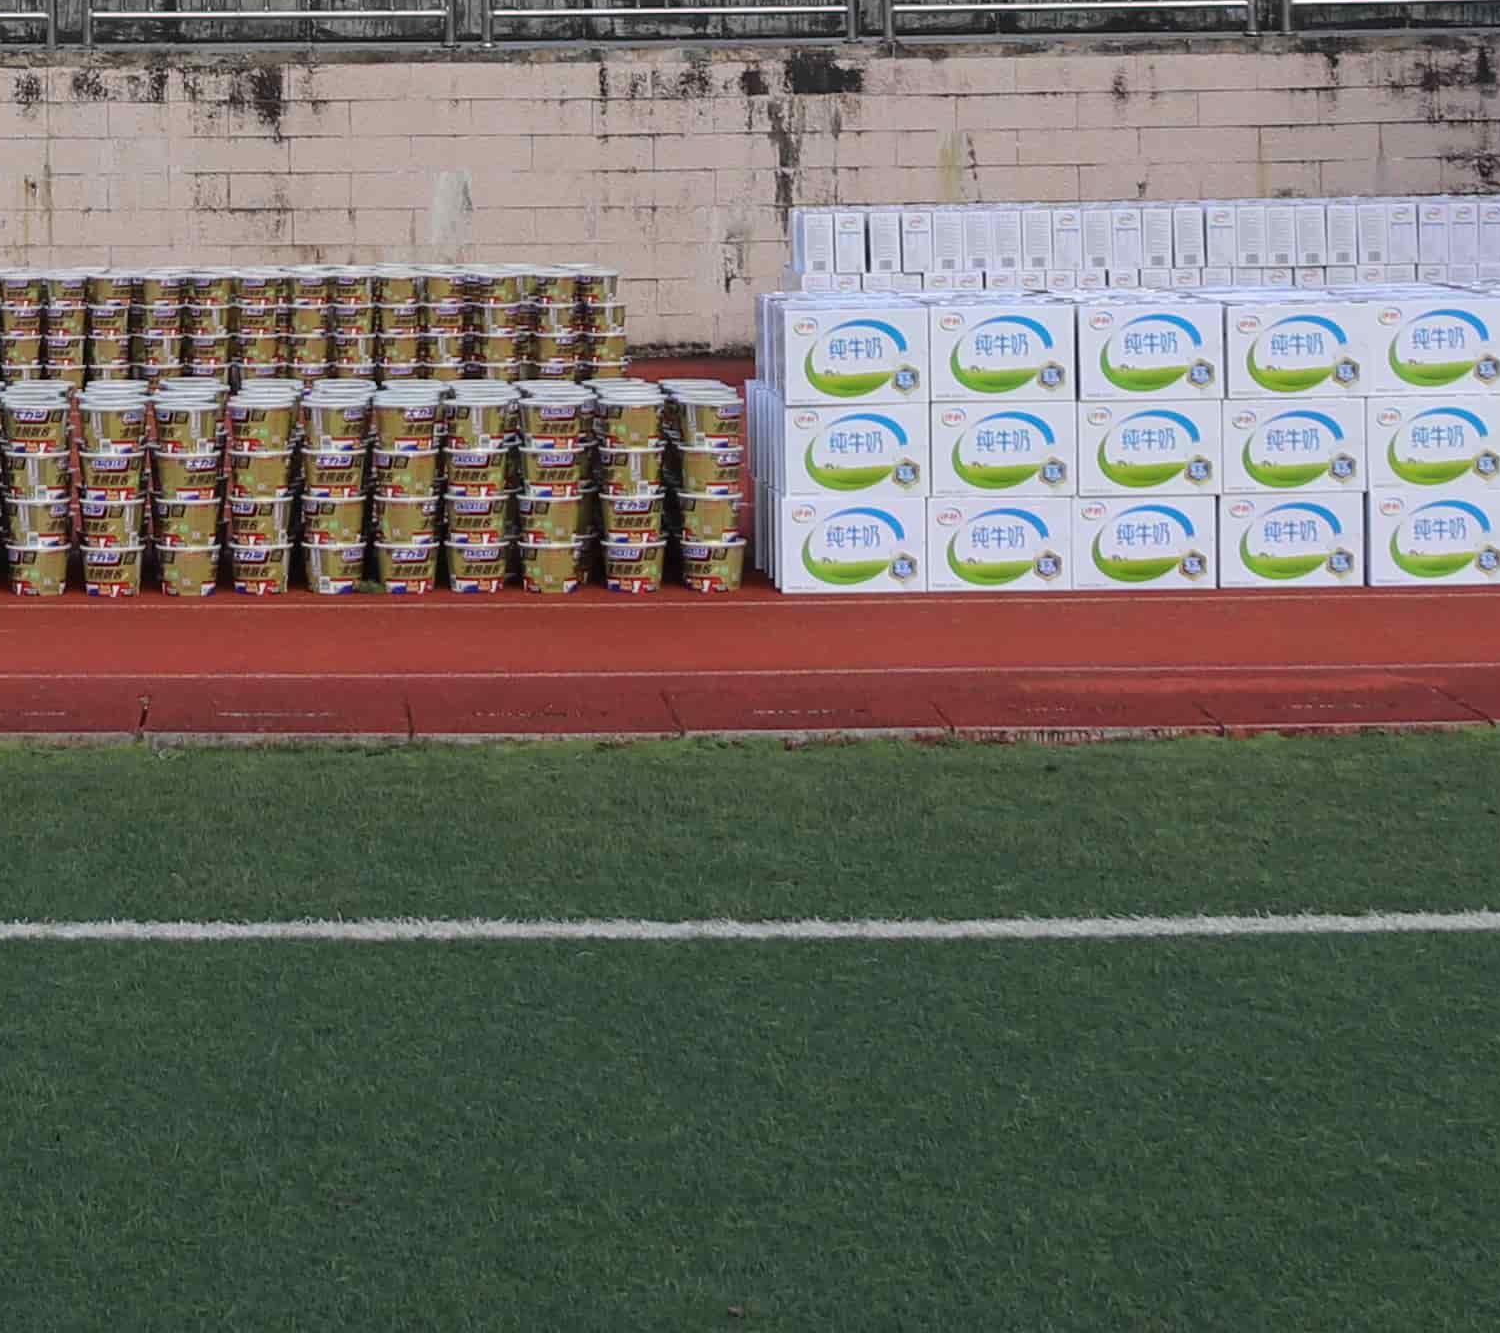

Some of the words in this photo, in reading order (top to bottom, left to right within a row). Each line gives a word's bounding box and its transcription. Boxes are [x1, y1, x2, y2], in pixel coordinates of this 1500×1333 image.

[828, 336, 882, 361] 纯牛奶
[974, 332, 1028, 357] 纯牛奶
[1123, 330, 1177, 355] 纯牛奶
[1269, 331, 1323, 356] 纯牛奶
[1411, 326, 1465, 351] 纯牛奶
[828, 430, 882, 455] 纯牛奶
[976, 428, 1030, 453] 纯牛奶
[1121, 426, 1175, 451] 纯牛奶
[1265, 427, 1319, 452] 纯牛奶
[1410, 424, 1464, 449] 纯牛奶
[826, 524, 880, 549] 纯牛奶
[971, 524, 1025, 549] 纯牛奶
[1116, 521, 1170, 546] 纯牛奶
[1263, 519, 1317, 544] 纯牛奶
[1412, 516, 1466, 541] 纯牛奶
